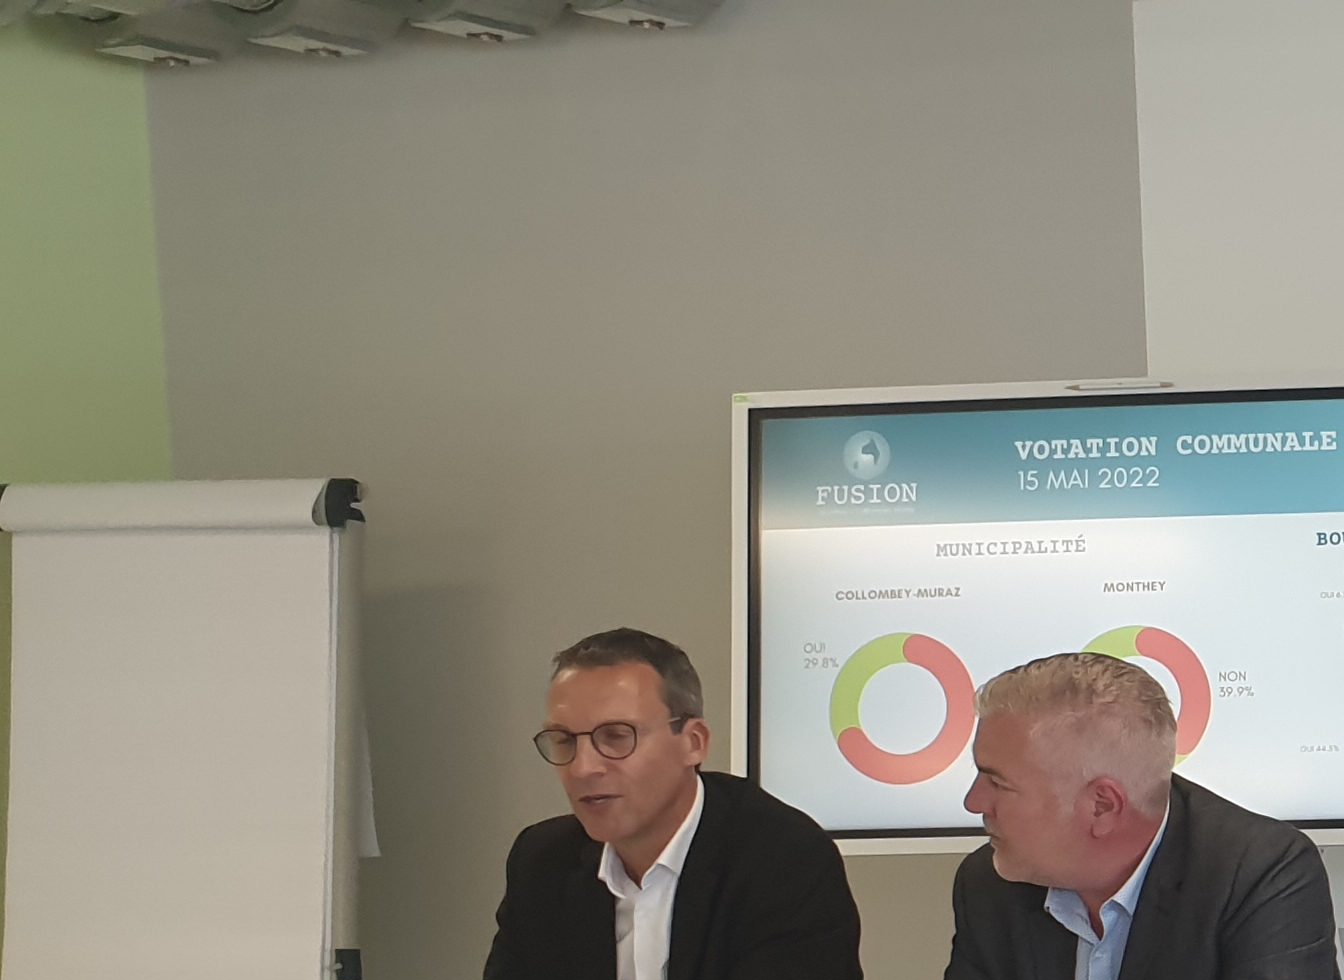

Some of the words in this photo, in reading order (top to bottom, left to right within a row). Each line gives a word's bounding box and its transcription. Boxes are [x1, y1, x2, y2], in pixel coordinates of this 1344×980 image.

[1015, 436, 1157, 460] VOTATION
[1176, 431, 1337, 455] COMMUNALE
[1017, 471, 1039, 490] 15
[1047, 469, 1089, 489] MAI
[1098, 467, 1160, 488] 2022
[816, 483, 917, 505] FUSION
[935, 535, 1087, 557] MUNICIPALITÉ
[1103, 581, 1166, 593] MONTHEY
[835, 587, 961, 601] COLLOMBEY-MURAZ
[803, 642, 826, 654] OUI
[803, 657, 839, 670] 29.8%
[1218, 671, 1247, 682] NON
[1218, 686, 1255, 698] 39.9%
